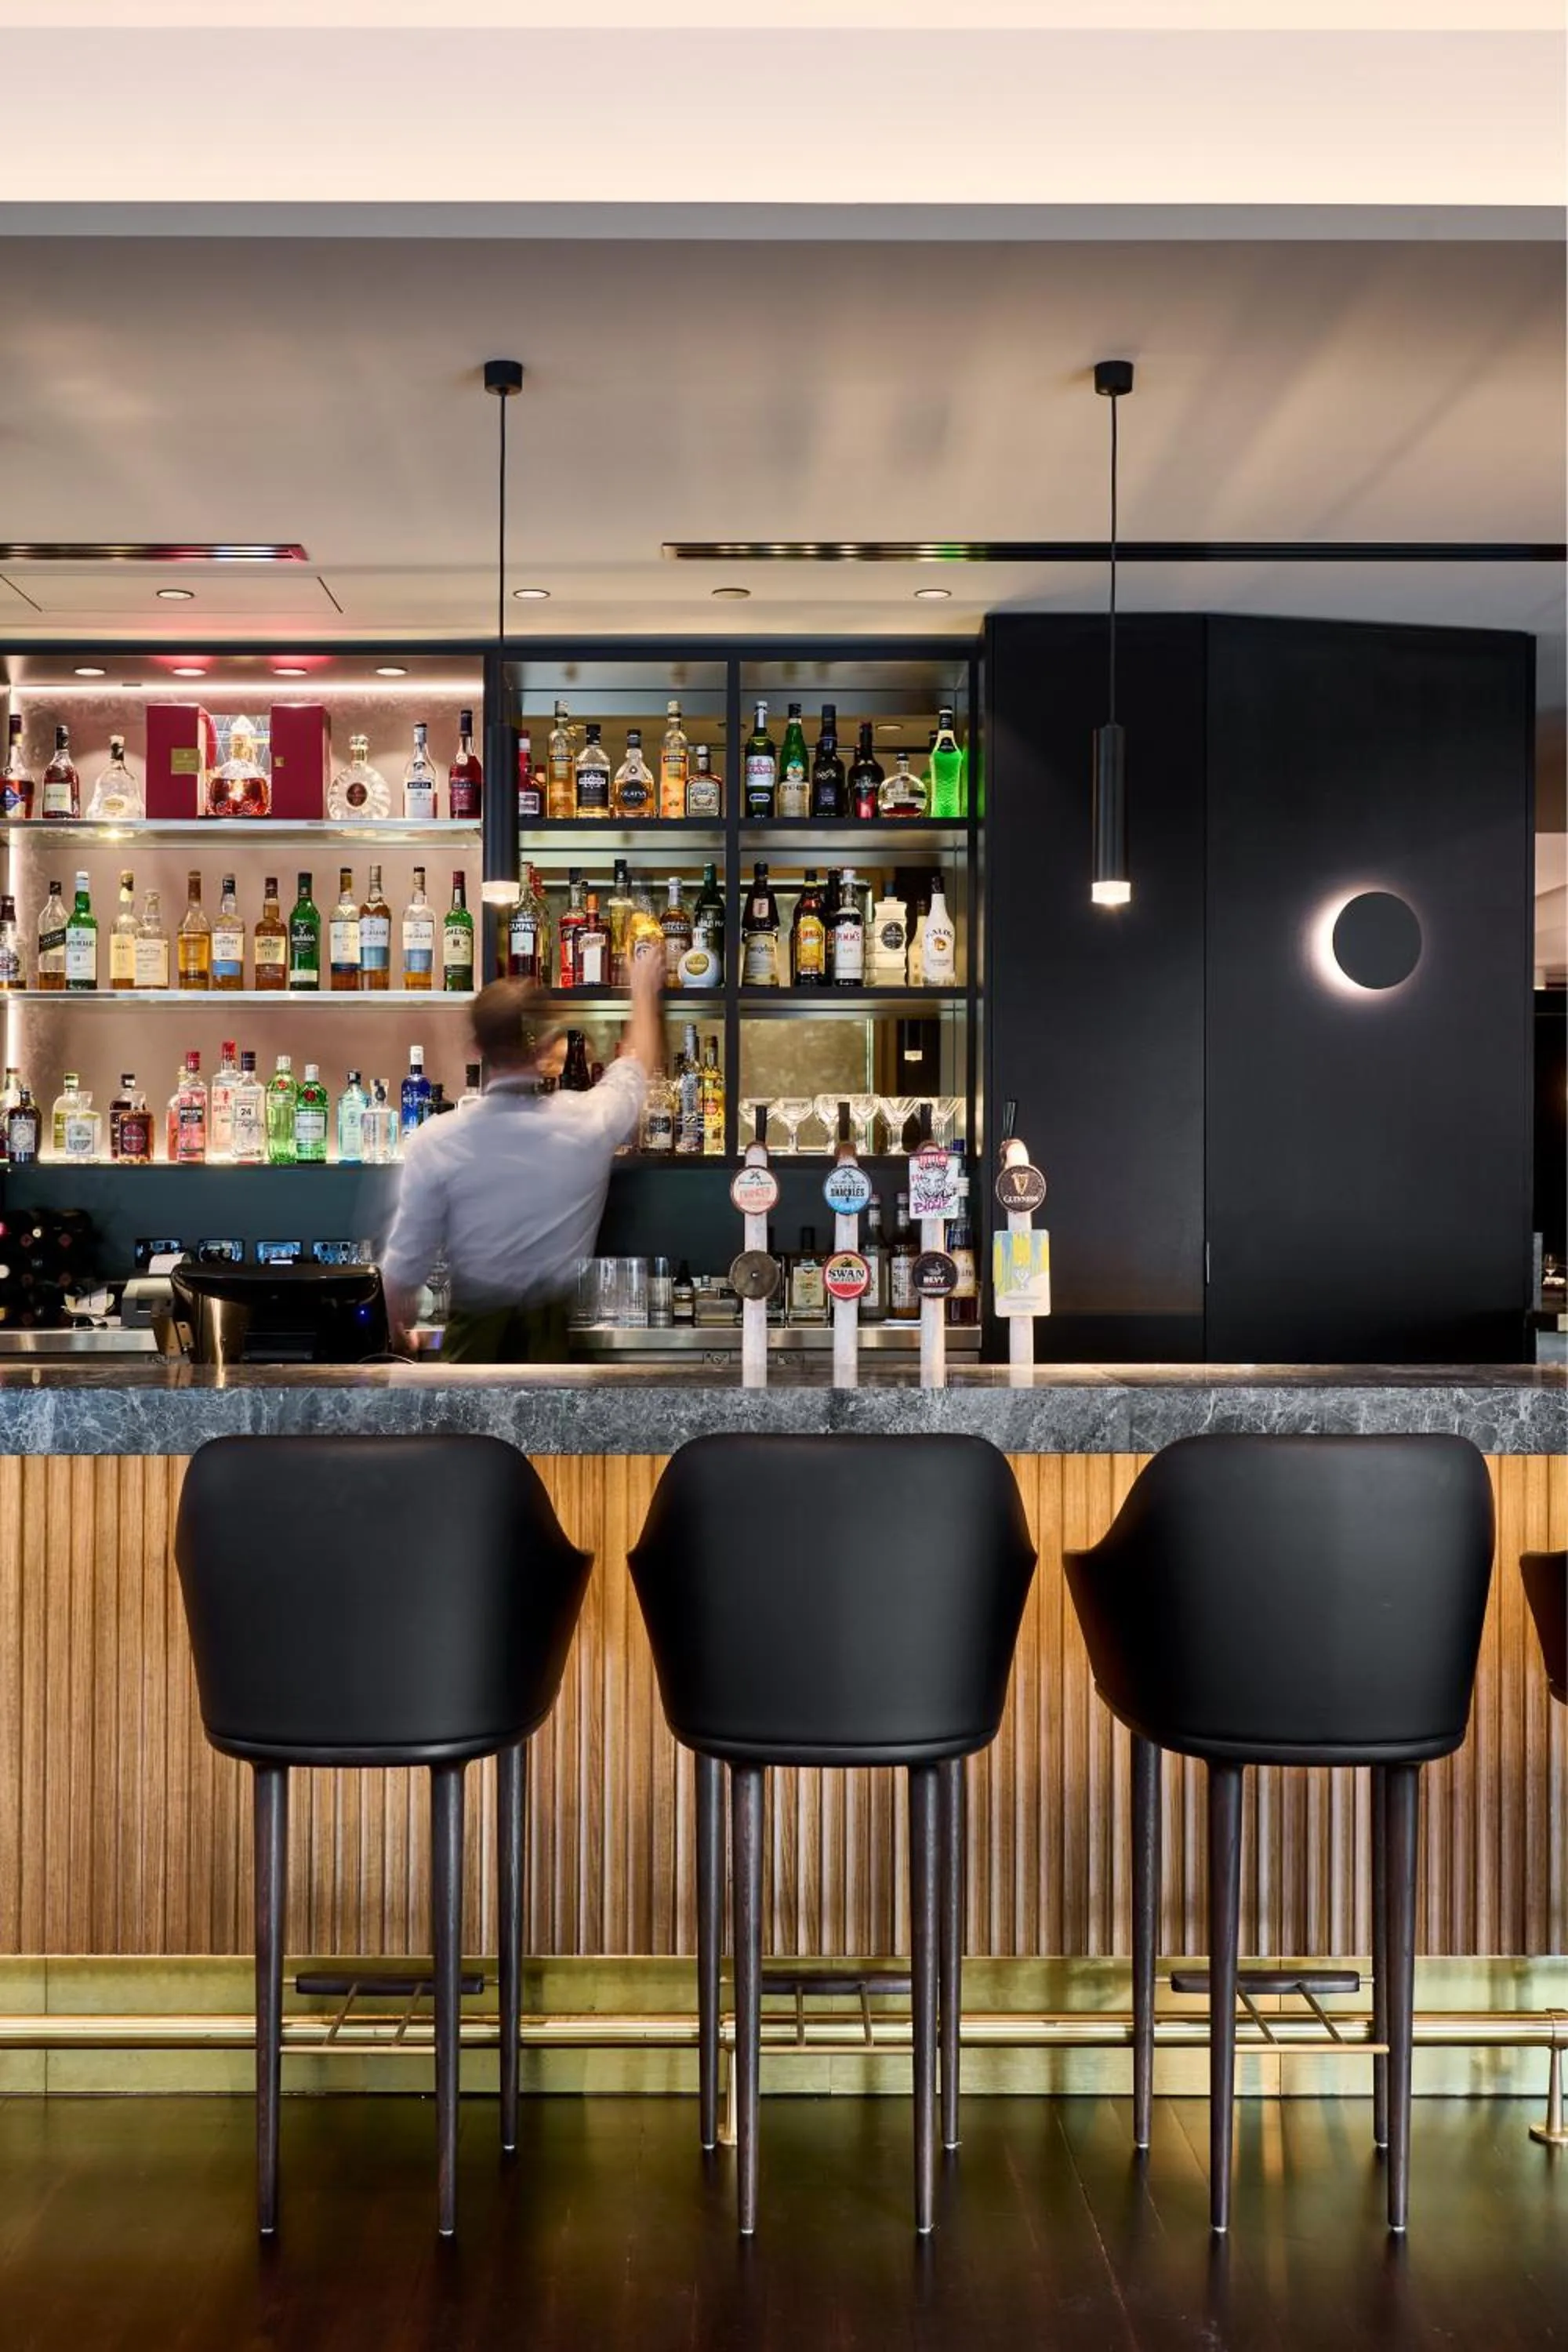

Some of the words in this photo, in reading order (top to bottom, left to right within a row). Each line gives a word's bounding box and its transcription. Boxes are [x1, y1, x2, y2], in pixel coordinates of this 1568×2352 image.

[241, 1107, 252, 1116] 24
[1003, 1194, 1039, 1203] GUINNESS
[827, 1269, 866, 1280] SWAN
